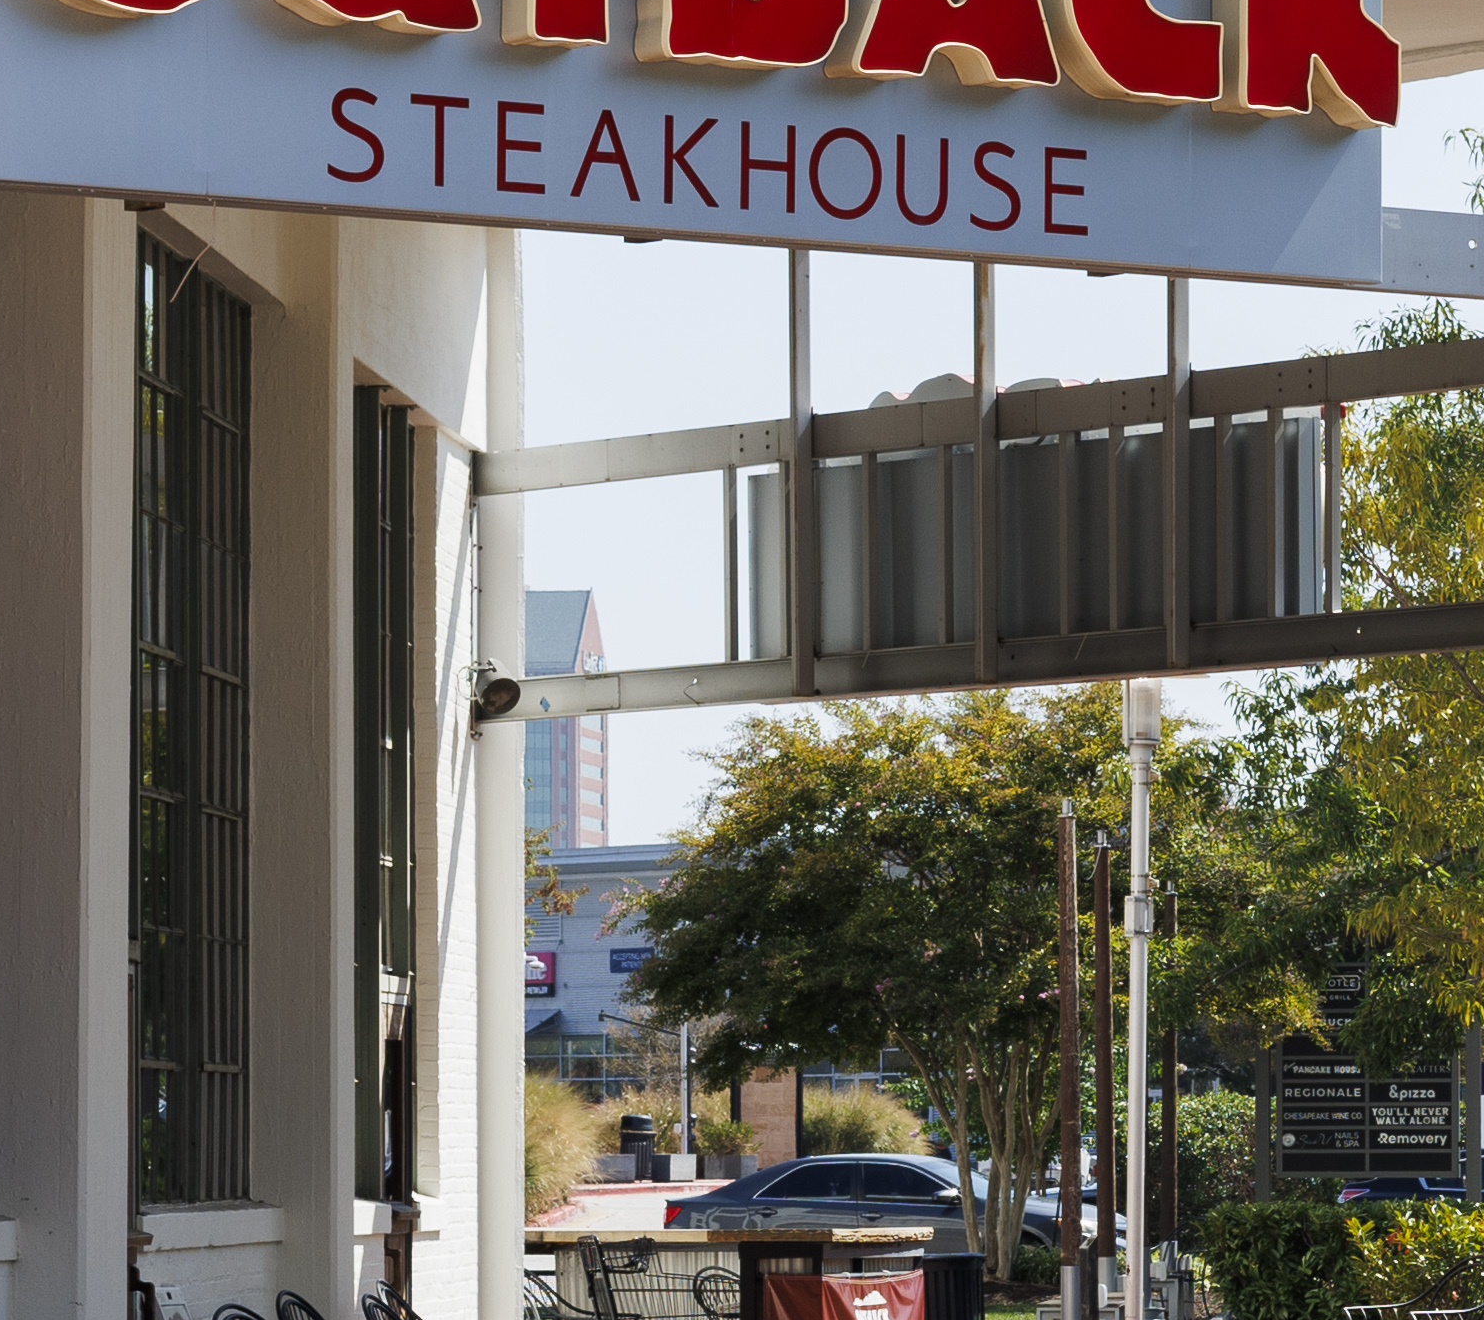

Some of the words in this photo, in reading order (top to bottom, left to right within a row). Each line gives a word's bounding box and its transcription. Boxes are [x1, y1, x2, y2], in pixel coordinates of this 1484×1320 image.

[327, 87, 1090, 238] STEAKHOUSE
[1292, 1065, 1331, 1074] PANCAKE
[1284, 1087, 1362, 1098] REGIONALE
[1389, 1084, 1436, 1101] &pizza
[1372, 1107, 1410, 1116] YOU'LL
[1413, 1107, 1449, 1116] NEVER
[1283, 1112, 1330, 1121] CHESAPEAKE
[1331, 1112, 1350, 1120] WINE
[1375, 1116, 1406, 1125] WALK
[1409, 1116, 1446, 1125] ALONE
[1334, 1131, 1360, 1140] NAILS
[1377, 1132, 1447, 1147] Removery
[1335, 1140, 1342, 1148] &
[1343, 1140, 1360, 1148] SPA
